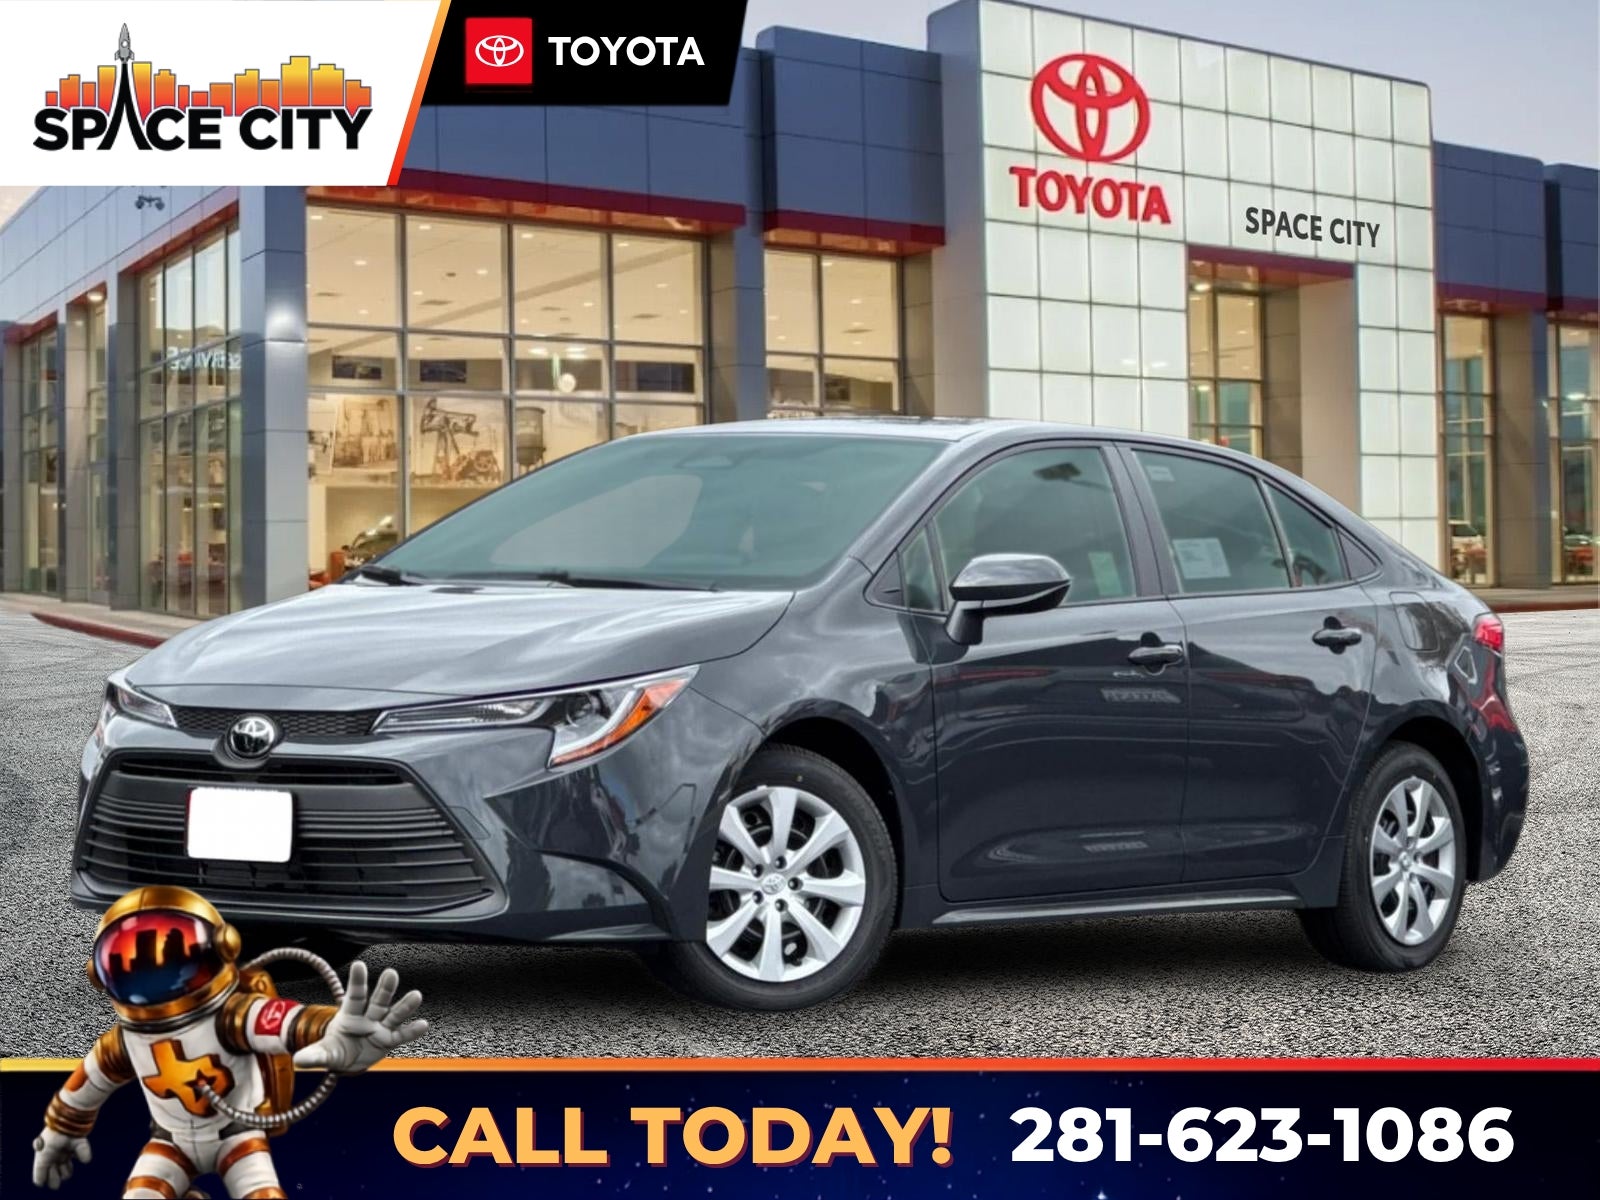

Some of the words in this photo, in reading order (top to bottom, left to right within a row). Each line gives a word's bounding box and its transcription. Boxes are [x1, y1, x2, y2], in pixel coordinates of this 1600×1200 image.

[1009, 166, 1171, 223] TOYOTA
[1245, 205, 1324, 243] SPACE
[1329, 218, 1381, 248] CITY
